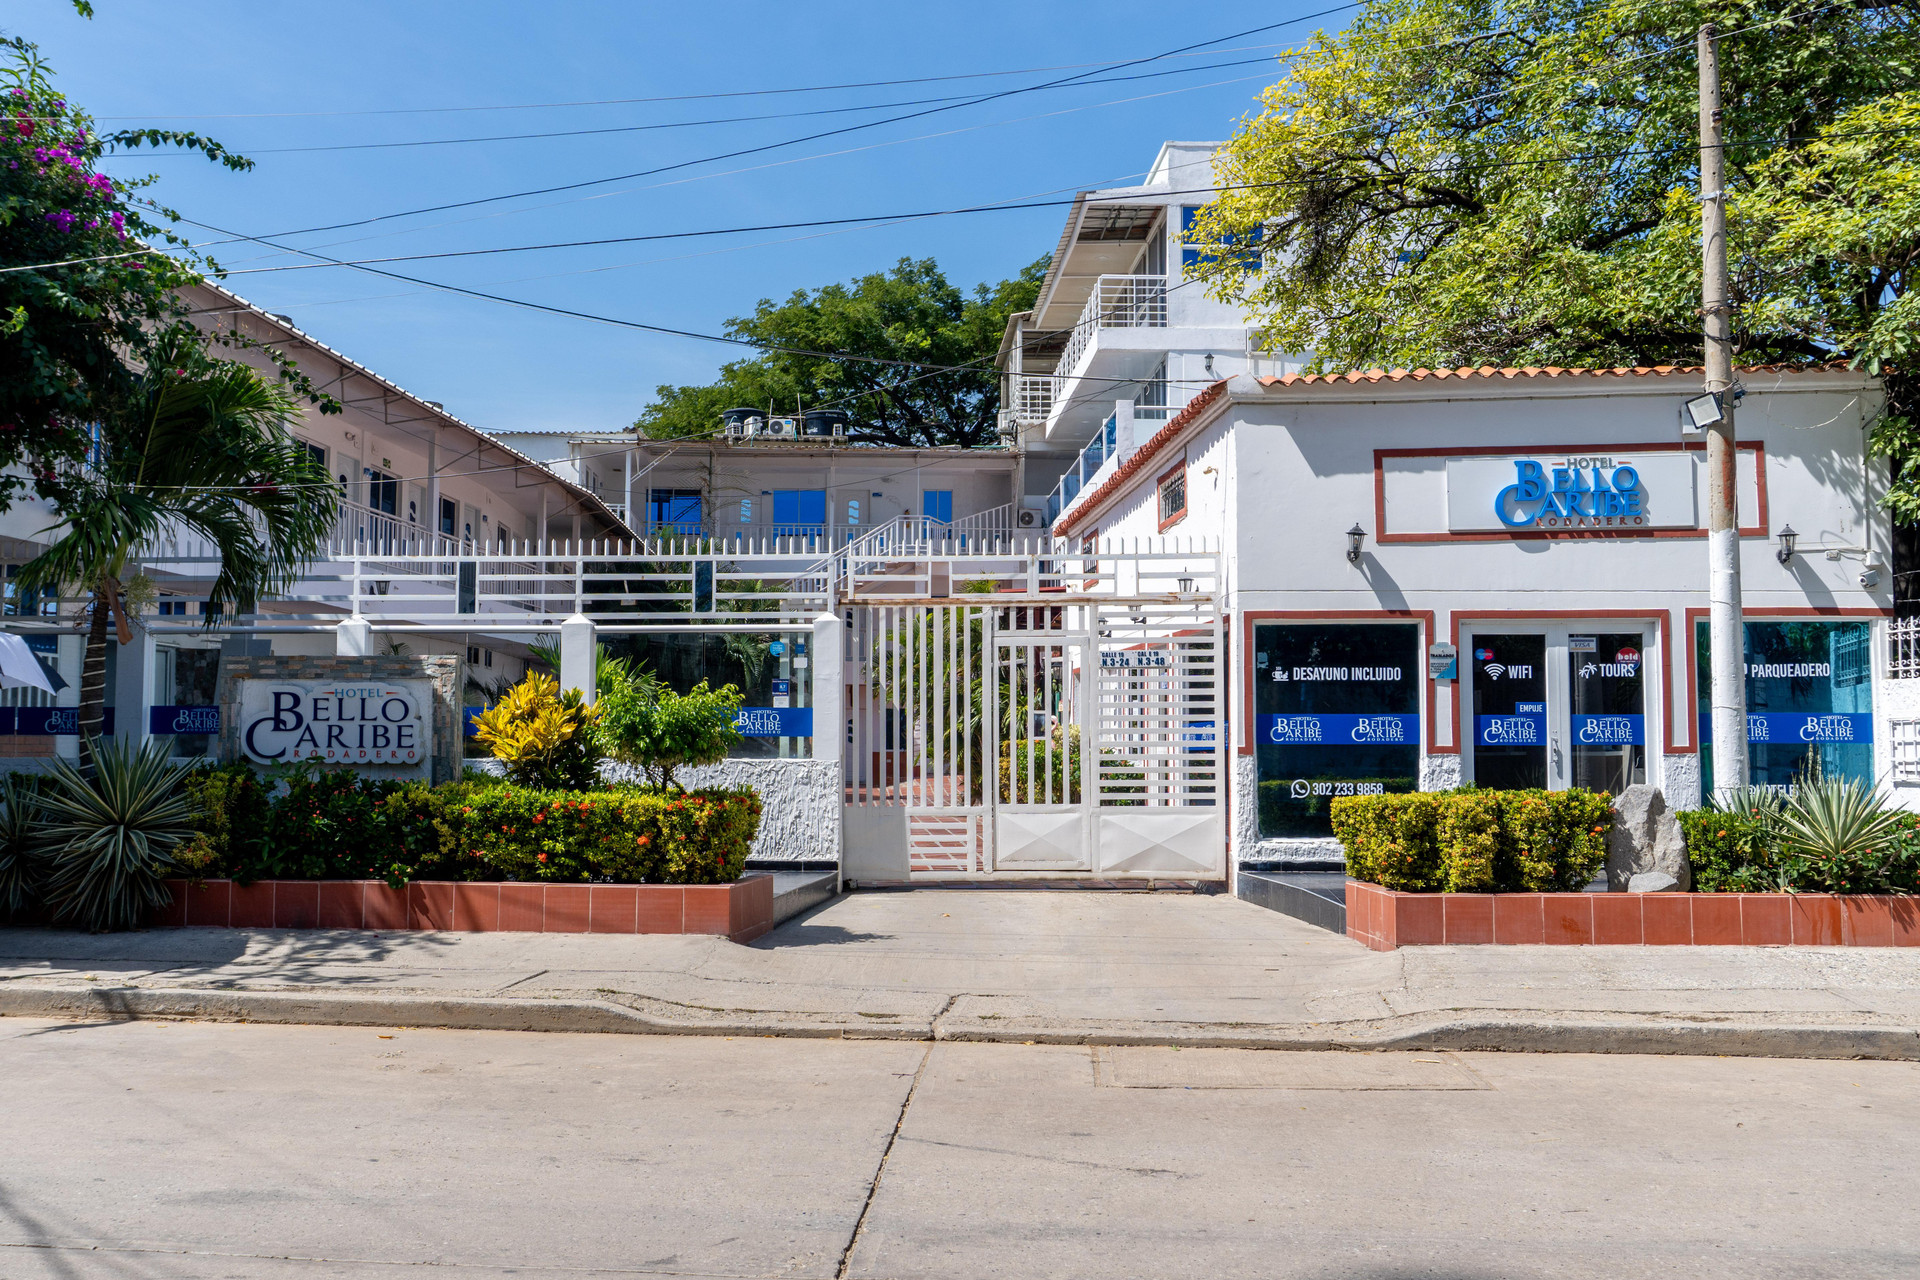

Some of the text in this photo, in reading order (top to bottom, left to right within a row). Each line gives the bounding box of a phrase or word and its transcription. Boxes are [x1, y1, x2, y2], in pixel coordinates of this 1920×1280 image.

[1567, 457, 1616, 469] HOTEL
[1514, 460, 1639, 501] BELLO
[1494, 484, 1642, 527] CARIBE
[1536, 516, 1643, 527] RODADERO
[1102, 658, 1130, 667] N.3-24
[1137, 657, 1165, 666] N.3-48
[1617, 652, 1639, 661] bold
[1293, 666, 1402, 681] DESAYUNO INCLUIDO
[1507, 665, 1532, 679] WIFI
[1599, 663, 1635, 677] TOURS
[1751, 663, 1830, 678] PARQUEADERO
[334, 688, 384, 698] HOTEL
[271, 691, 409, 732] BELLO
[1519, 704, 1543, 713] EMPUJE
[51, 710, 79, 725] BELL
[180, 709, 218, 724] BELLO
[739, 711, 780, 726] BELLO
[44, 718, 79, 733] CARI
[1277, 718, 1321, 733] BELLO
[1358, 718, 1402, 733] BELLO
[1491, 719, 1535, 735] BELLO
[1586, 718, 1631, 734] BELLO
[1807, 717, 1852, 732] BELLO
[245, 716, 415, 760] CARIBE
[1270, 726, 1323, 742] CARIBE
[1351, 726, 1404, 742] CARIBE
[1483, 727, 1537, 743] CARIBE
[1579, 727, 1633, 743] CARIBE
[1799, 725, 1854, 741] CARIBE
[293, 750, 416, 759] RODADERO
[1312, 782, 1384, 796] 302 233 9858
